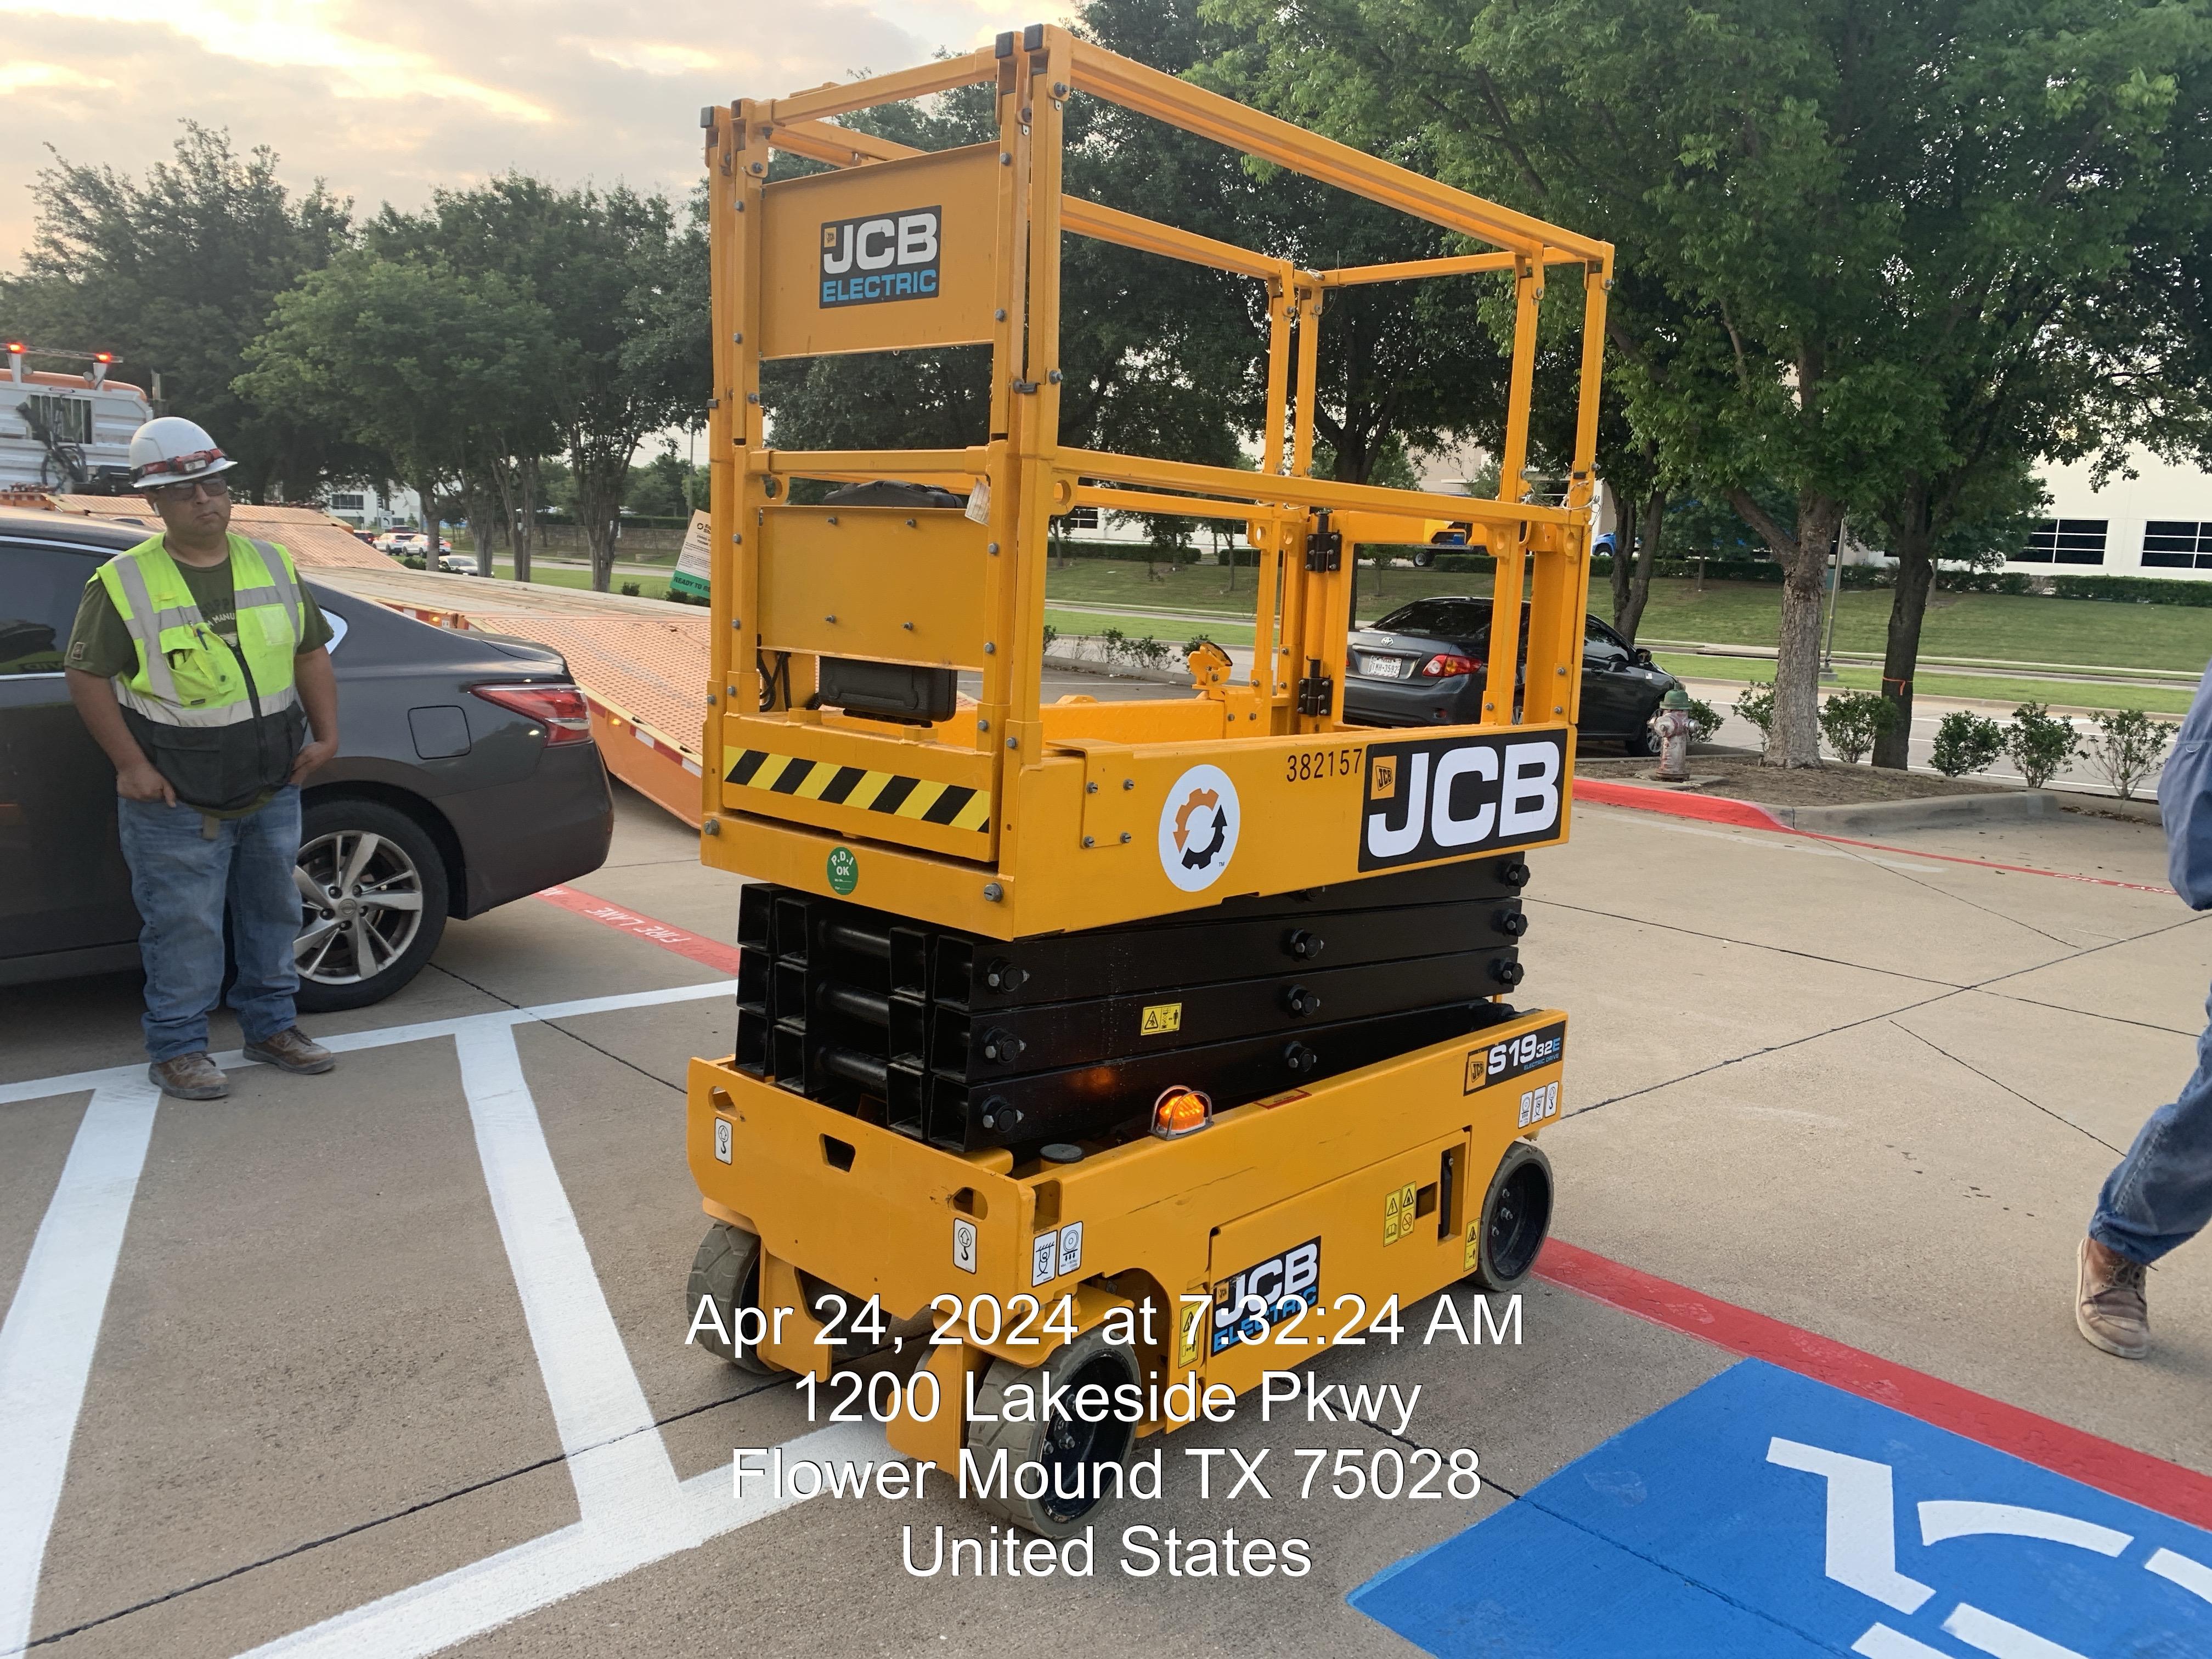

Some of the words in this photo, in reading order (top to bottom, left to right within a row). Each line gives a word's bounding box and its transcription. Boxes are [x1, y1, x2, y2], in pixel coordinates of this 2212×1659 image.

[823, 213, 937, 274] JCB
[823, 269, 936, 302] ELECTRIC
[674, 577, 694, 586] READY
[212, 612, 235, 624] MANU
[1286, 748, 1362, 782] 382157
[1378, 768, 1392, 788] JCB
[1368, 741, 1560, 857] JCB
[836, 866, 850, 876] OK
[583, 907, 646, 926] LANE
[633, 926, 692, 943] FIRE
[1523, 1058, 1545, 1071] ELECTRIC
[1545, 1053, 1560, 1062] DRIVE
[1215, 1243, 1317, 1328] JCB
